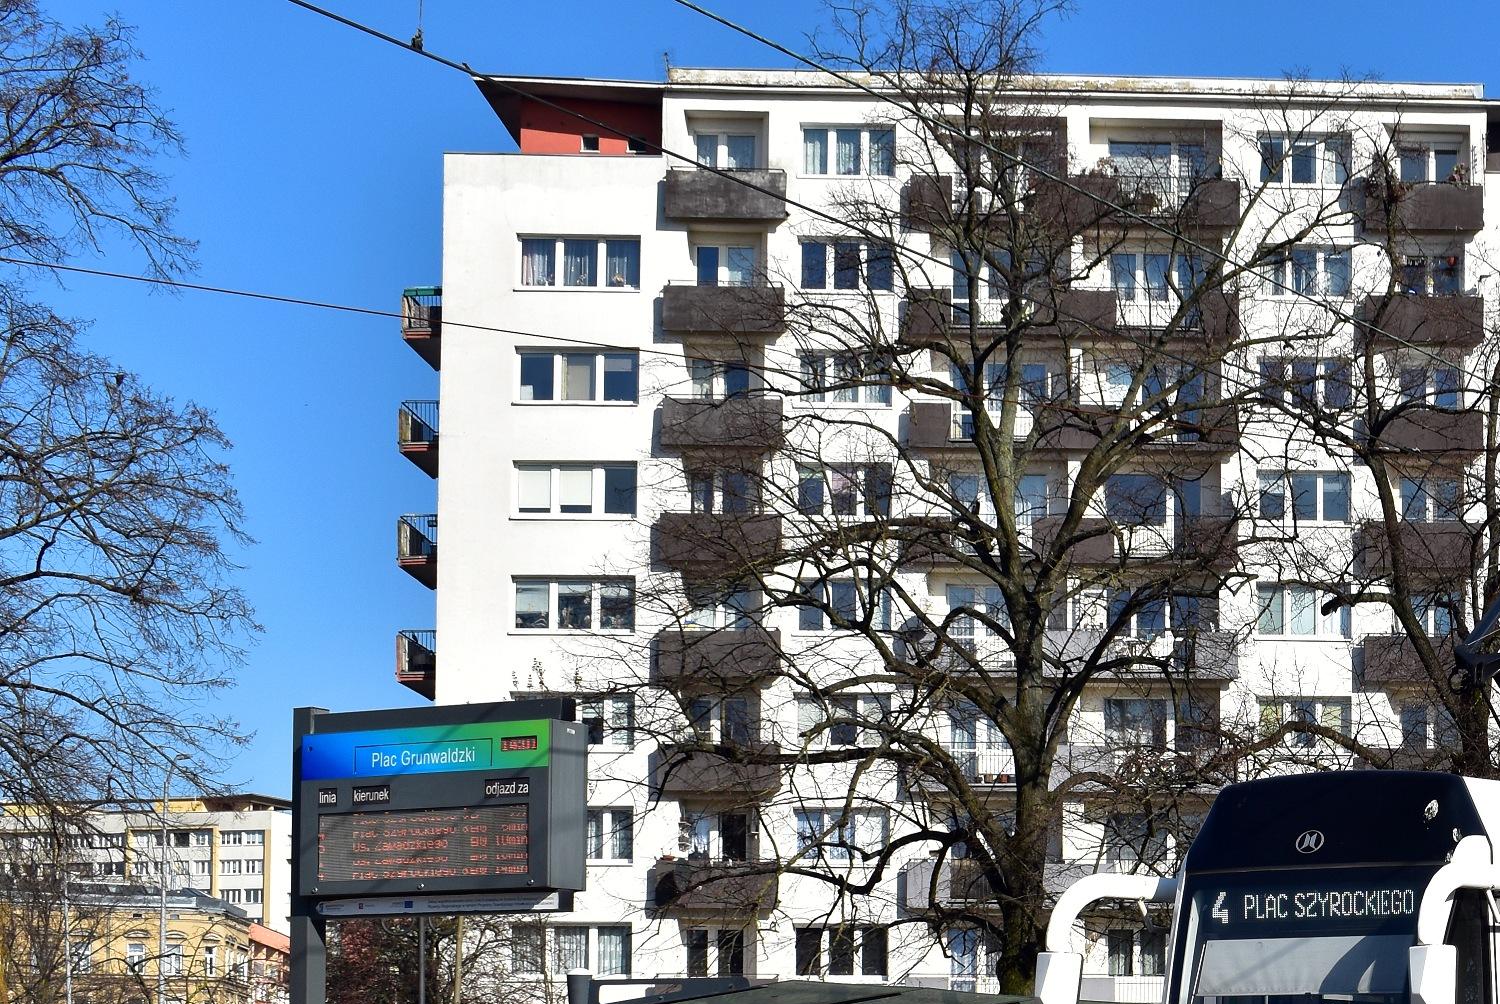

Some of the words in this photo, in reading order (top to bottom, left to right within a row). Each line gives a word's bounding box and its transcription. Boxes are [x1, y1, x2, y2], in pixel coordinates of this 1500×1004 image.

[371, 752, 397, 768] Plac
[401, 747, 475, 766] Grunwaldzki
[319, 792, 337, 804] linia
[353, 787, 389, 802] kierunek
[485, 782, 516, 798] odjazd
[518, 783, 529, 794] za
[1212, 891, 1229, 924] 4
[1244, 893, 1288, 919] PLAC
[1294, 889, 1414, 918] SZYROCKIEGO
